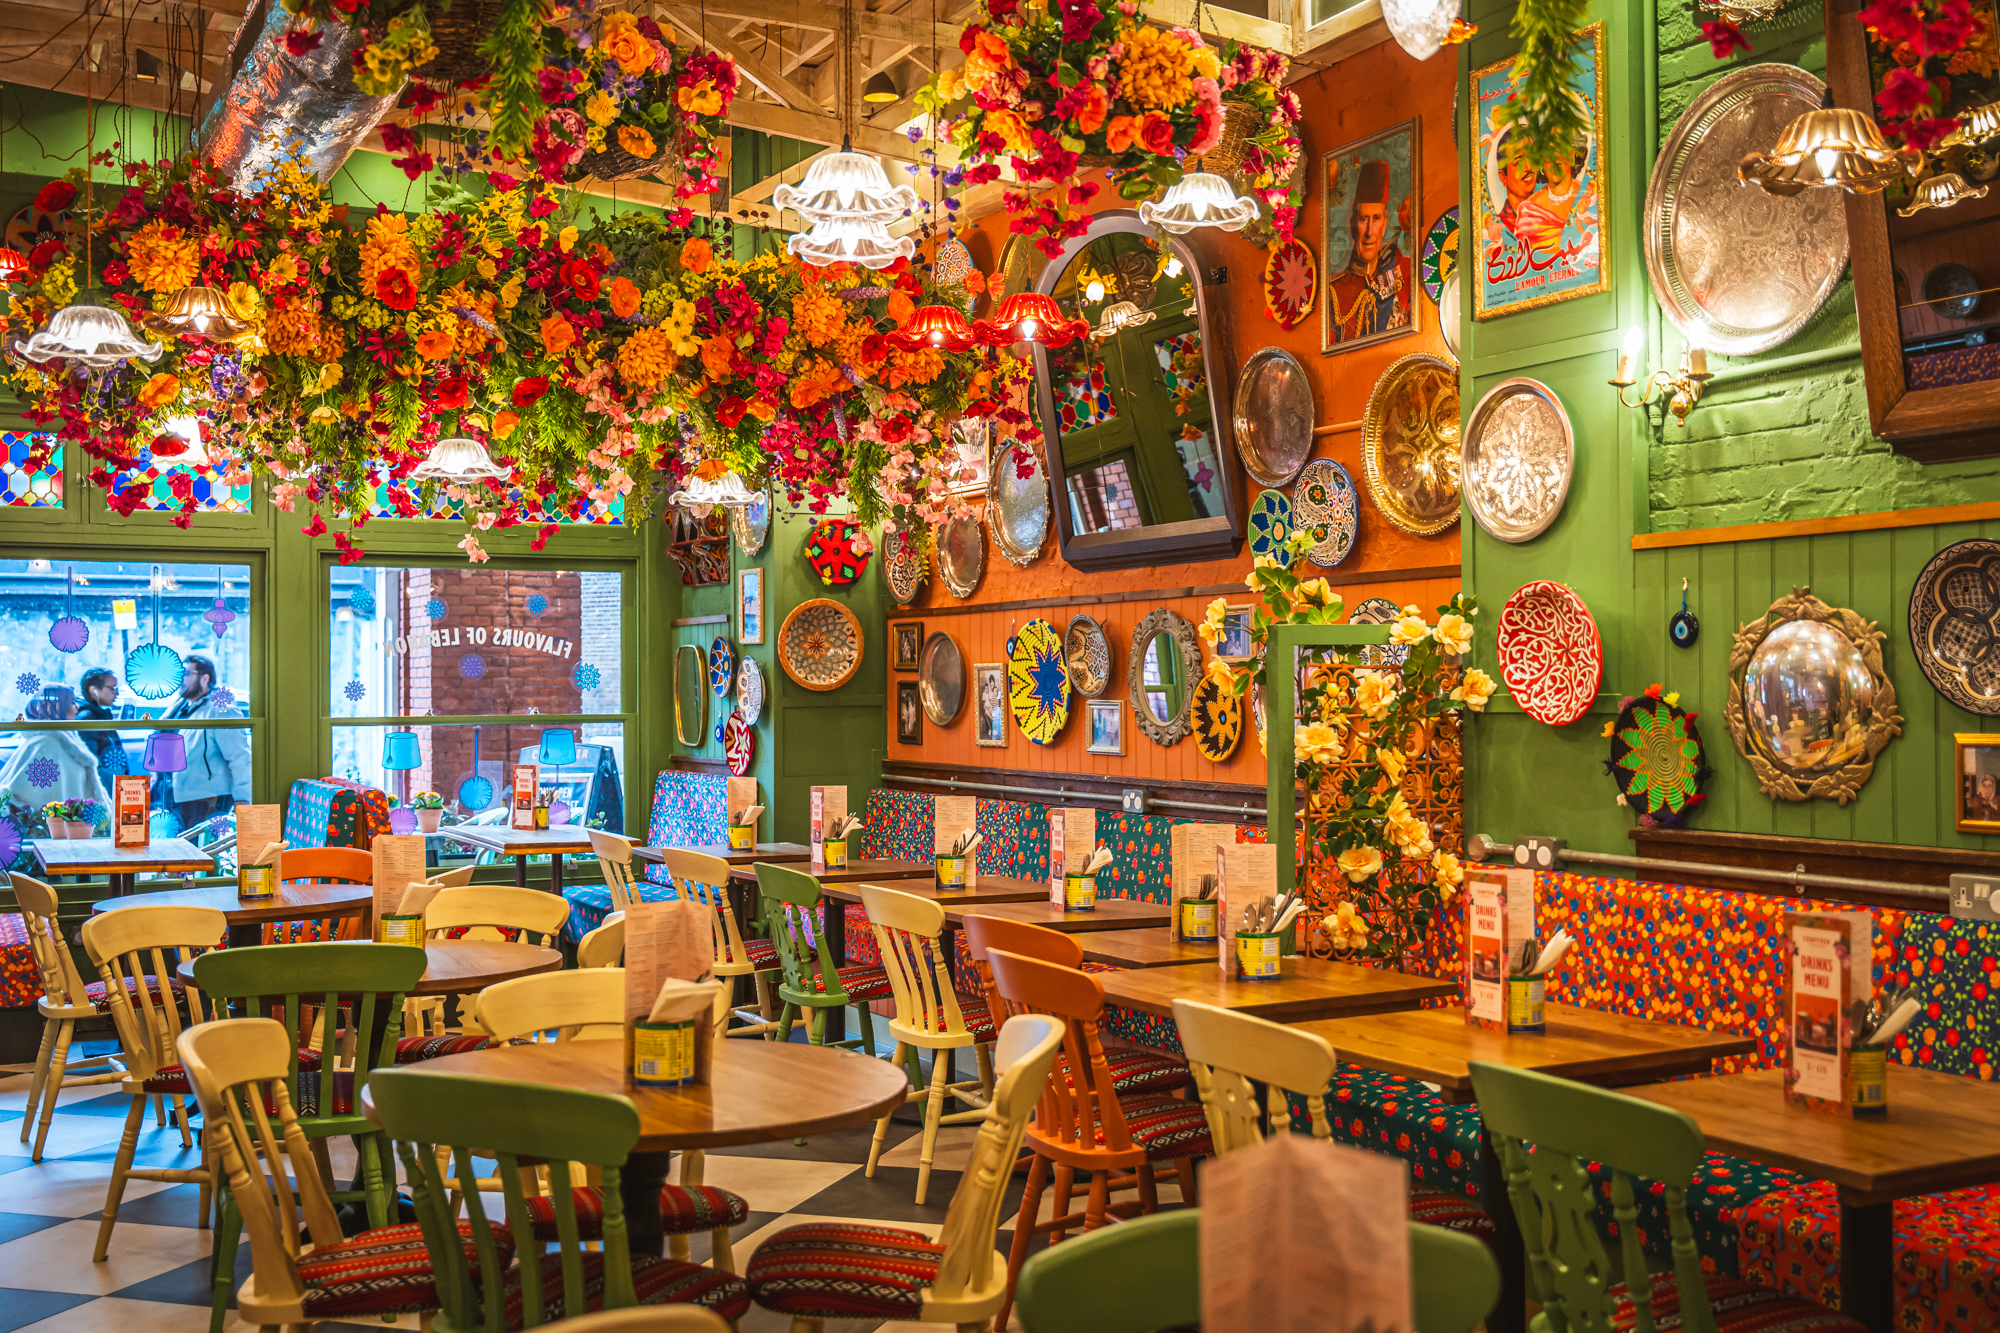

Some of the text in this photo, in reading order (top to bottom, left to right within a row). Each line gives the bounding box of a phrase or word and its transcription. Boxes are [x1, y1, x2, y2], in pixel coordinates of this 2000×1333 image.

[1476, 904, 1496, 918] DRINKS
[1478, 918, 1495, 931] MENU
[1801, 955, 1832, 972] DRINKS
[1804, 972, 1829, 989] MENU
